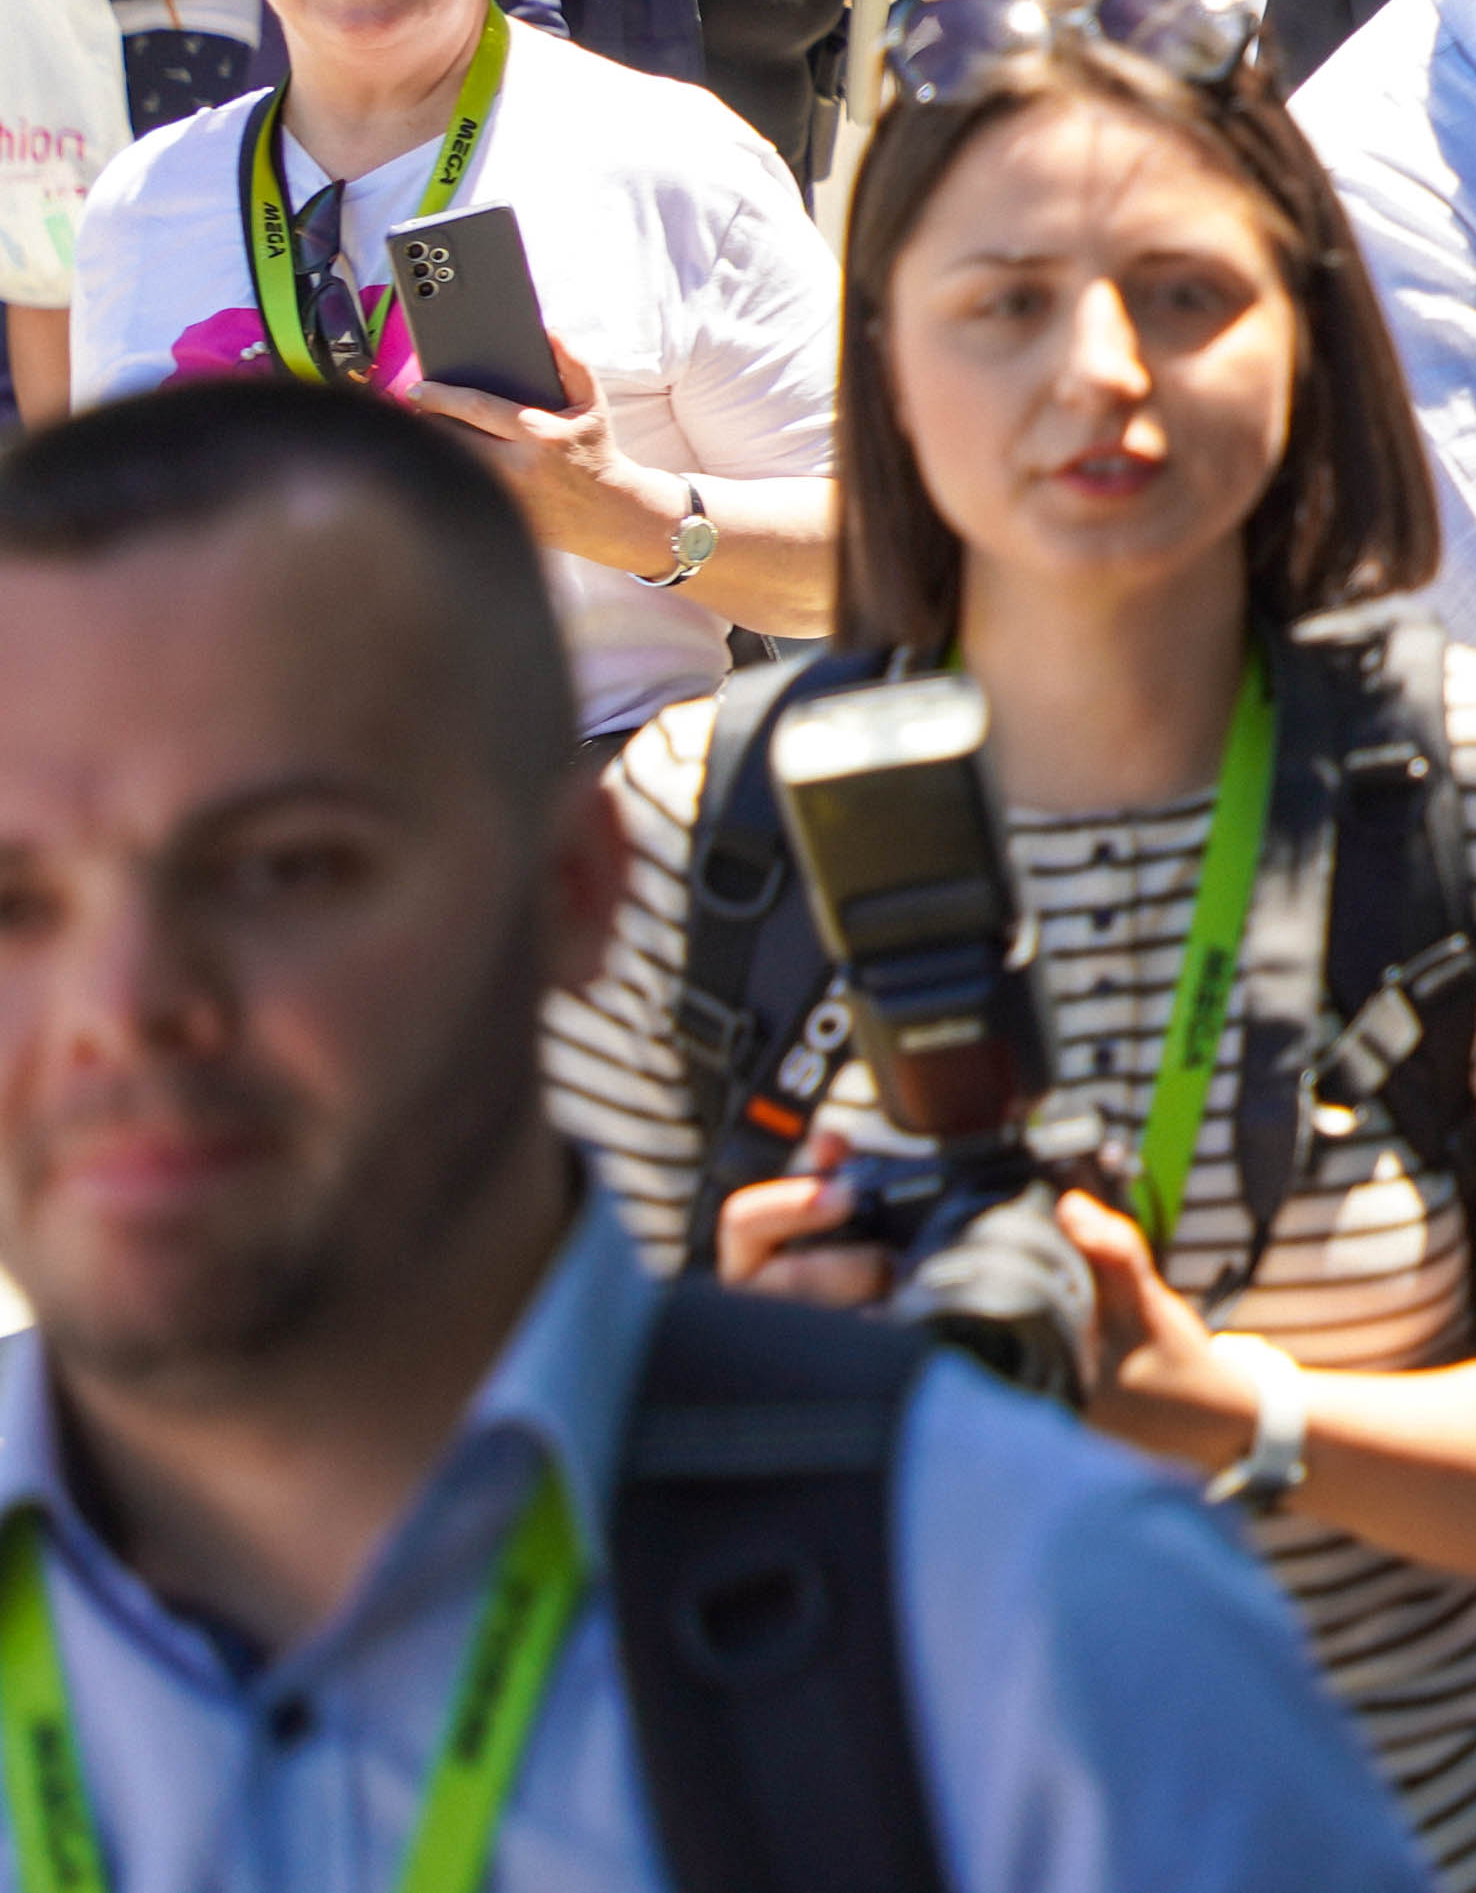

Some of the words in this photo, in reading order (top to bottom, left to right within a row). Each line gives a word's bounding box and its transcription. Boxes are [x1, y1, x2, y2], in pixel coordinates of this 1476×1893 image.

[439, 117, 478, 187] MEGA
[263, 201, 287, 260] MEGA
[777, 978, 853, 1099] SO
